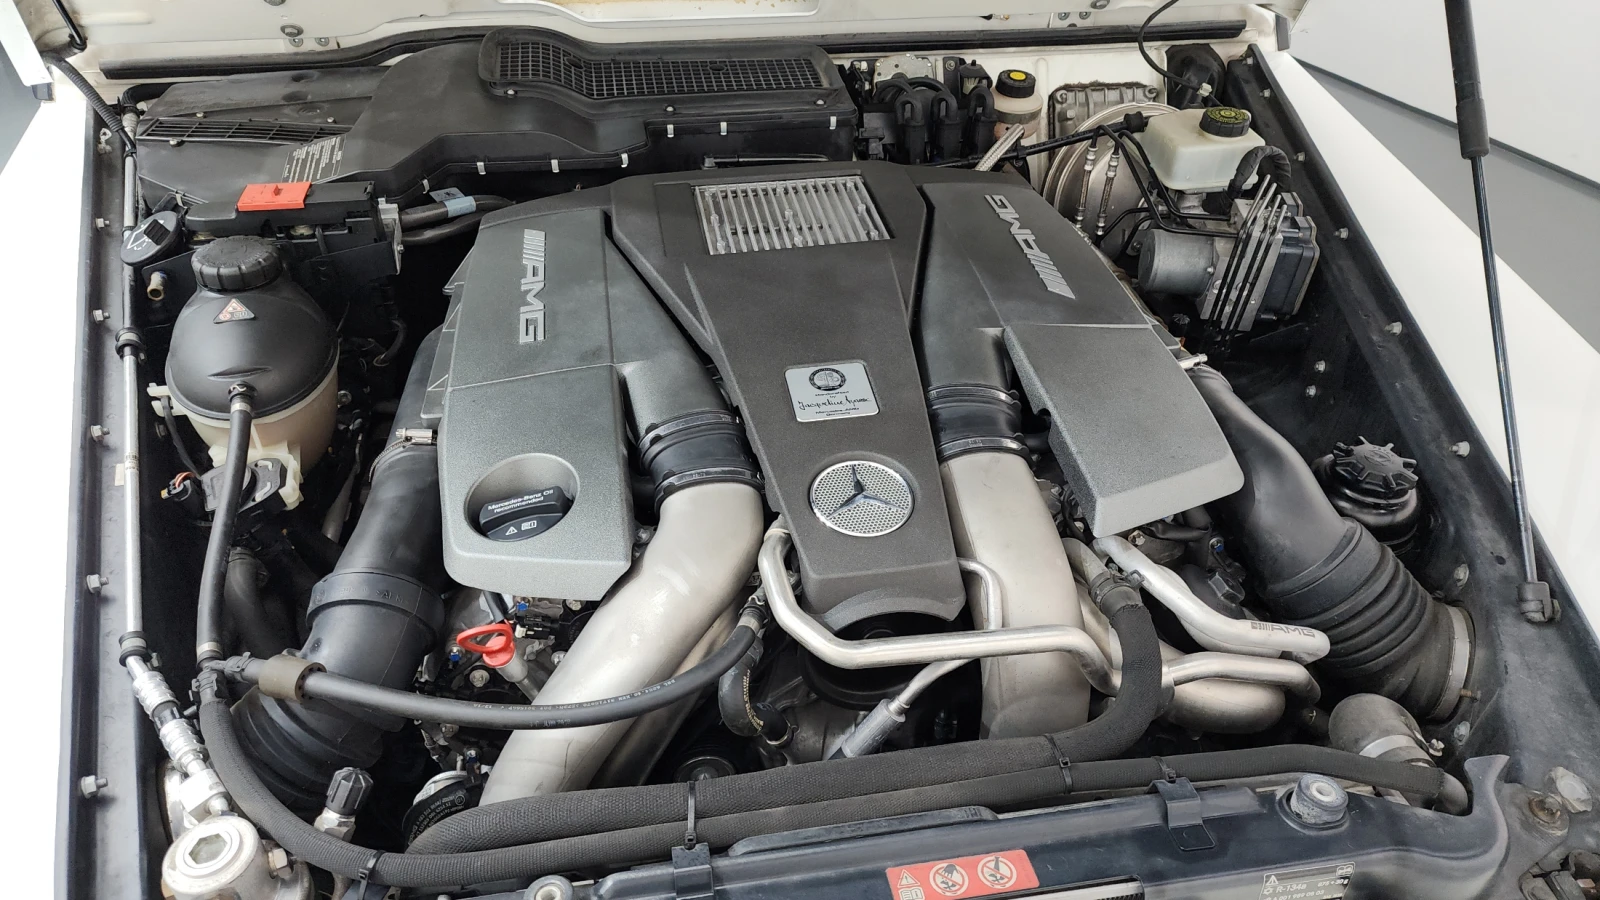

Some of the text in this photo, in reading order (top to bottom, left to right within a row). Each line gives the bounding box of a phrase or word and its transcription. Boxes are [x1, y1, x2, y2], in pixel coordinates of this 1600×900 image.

[520, 257, 546, 345] AMG
[487, 493, 542, 511] Mercedes-Benz
[494, 496, 544, 513] recommended
